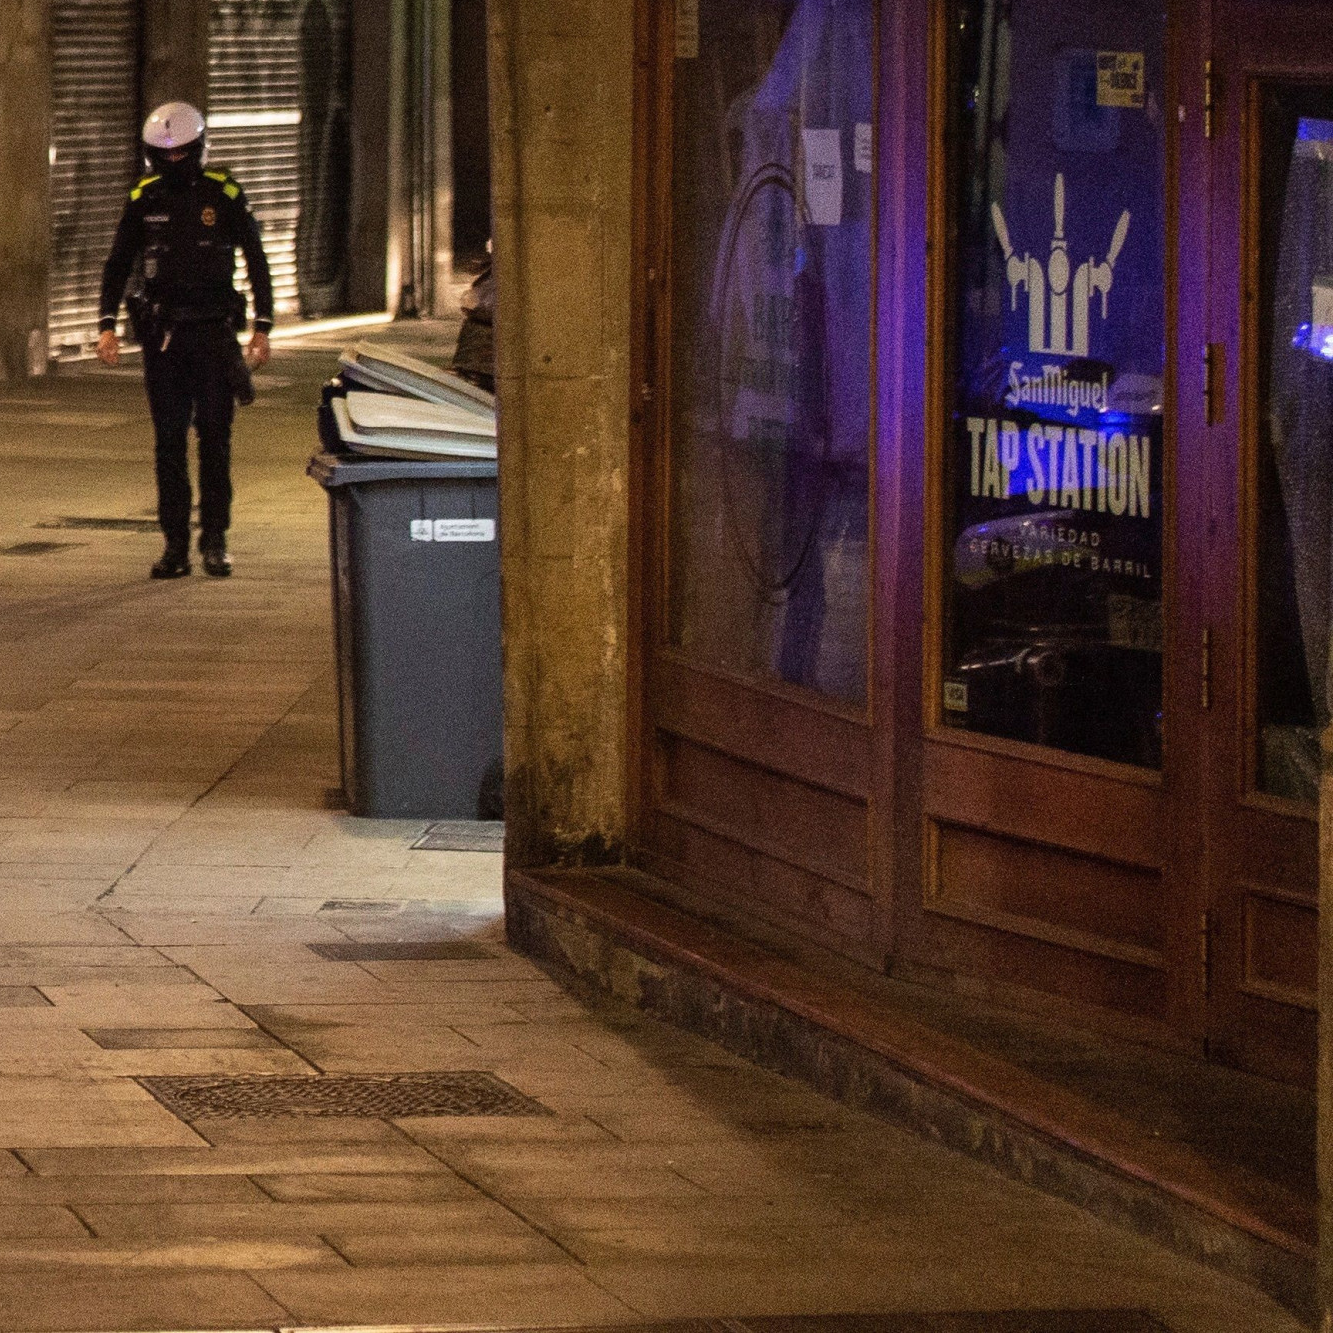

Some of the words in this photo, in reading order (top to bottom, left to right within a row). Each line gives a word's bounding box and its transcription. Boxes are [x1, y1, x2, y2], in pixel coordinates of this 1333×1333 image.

[966, 417, 1020, 500] TAP
[1026, 422, 1152, 519] STATION
[1019, 524, 1101, 547] VARIEDAD
[968, 538, 1054, 564] CERVEZAS
[1061, 551, 1082, 569] DE
[1090, 554, 1152, 578] BARRIL
